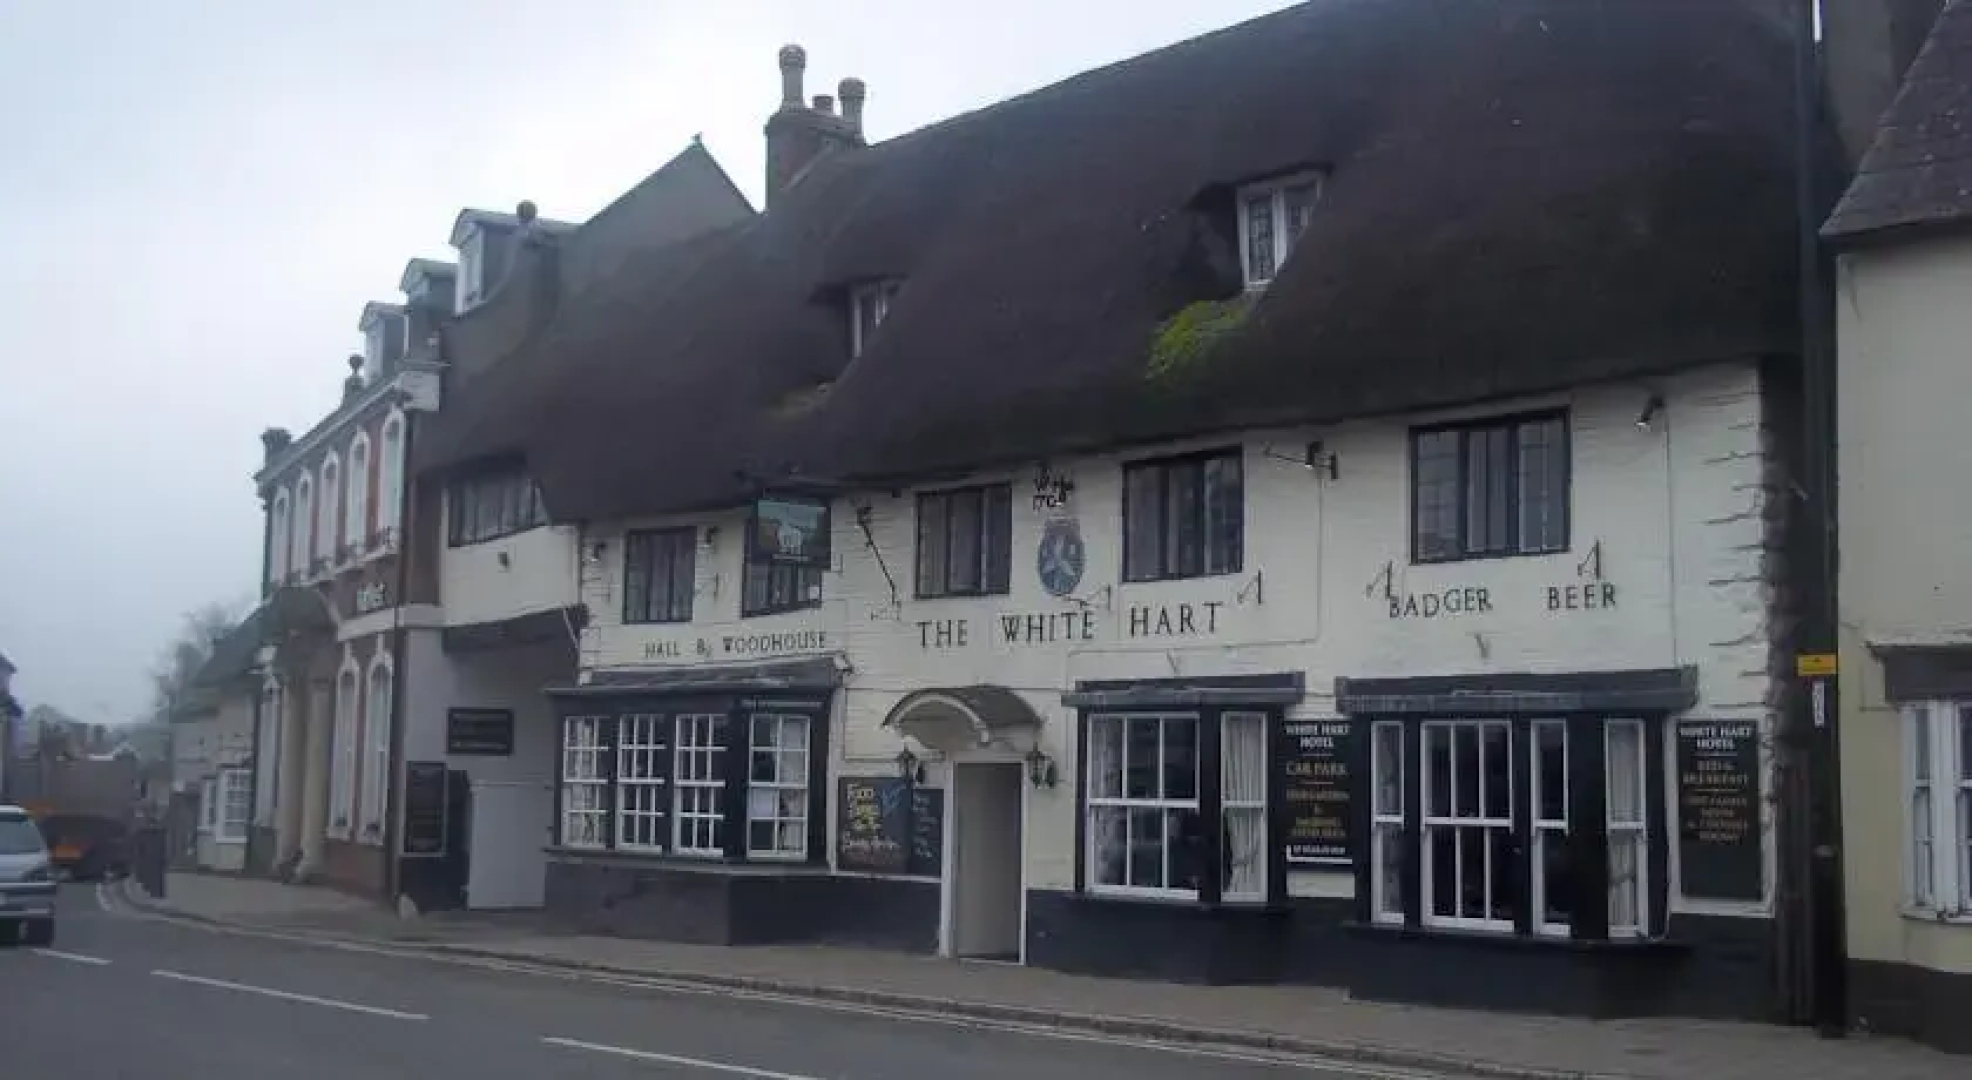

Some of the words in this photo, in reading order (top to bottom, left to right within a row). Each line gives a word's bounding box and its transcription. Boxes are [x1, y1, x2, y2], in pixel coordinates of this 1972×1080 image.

[1389, 587, 1494, 618] BADGER
[1547, 582, 1617, 611] BEER
[915, 619, 969, 648] THE
[1001, 610, 1094, 643] WHITE
[1129, 601, 1223, 639] HART
[645, 640, 682, 658] HALL
[722, 631, 827, 654] WOODHOUSE
